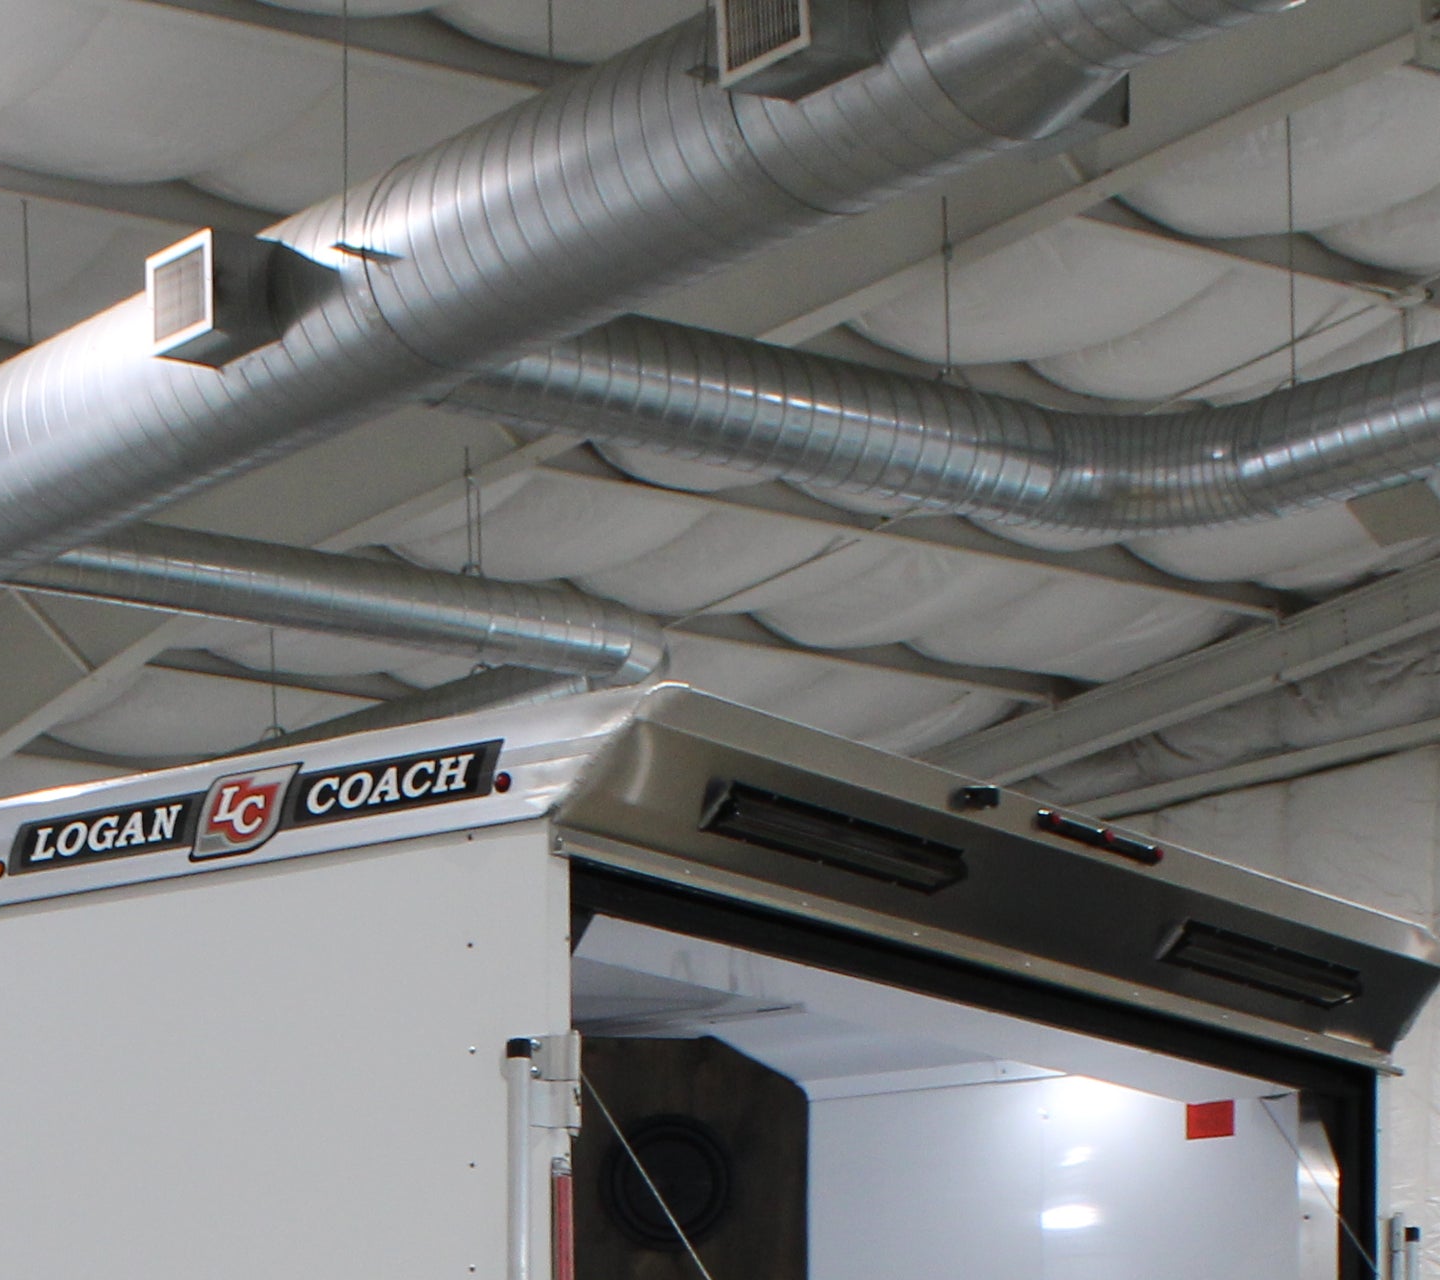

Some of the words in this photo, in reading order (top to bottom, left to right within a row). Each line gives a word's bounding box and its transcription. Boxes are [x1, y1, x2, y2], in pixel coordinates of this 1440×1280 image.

[29, 803, 184, 863] LOGAN
[211, 785, 267, 836] LC
[305, 753, 476, 816] COACH
